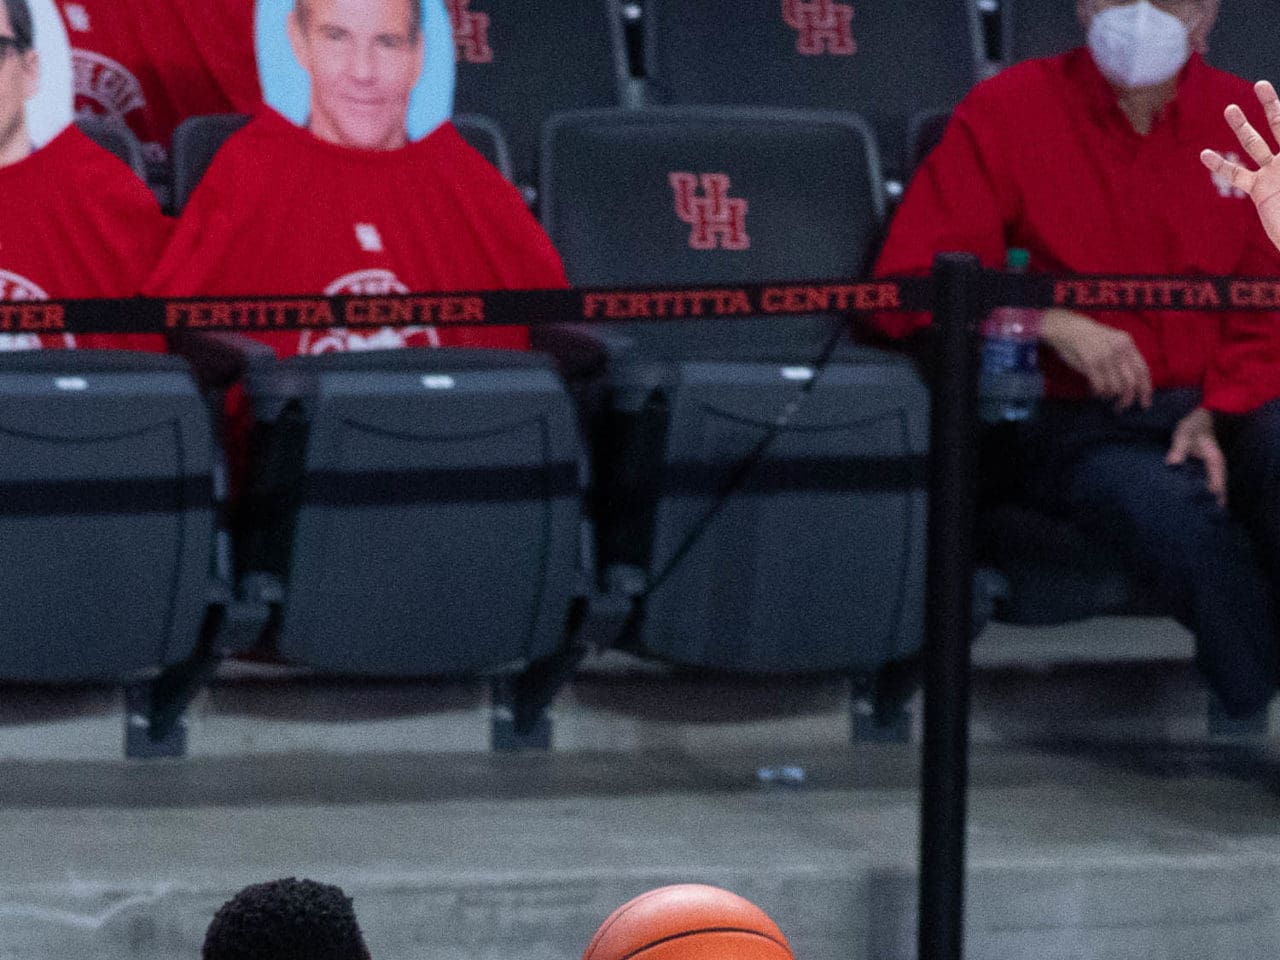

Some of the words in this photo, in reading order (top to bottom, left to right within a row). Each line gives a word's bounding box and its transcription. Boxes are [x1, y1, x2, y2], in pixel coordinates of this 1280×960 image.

[668, 171, 750, 250] UH
[583, 289, 750, 319] FERTITTA
[761, 282, 898, 312] CENTER
[1053, 280, 1220, 306] FERTITTA
[165, 300, 334, 328] FERTITTA
[346, 297, 484, 325] CENTER
